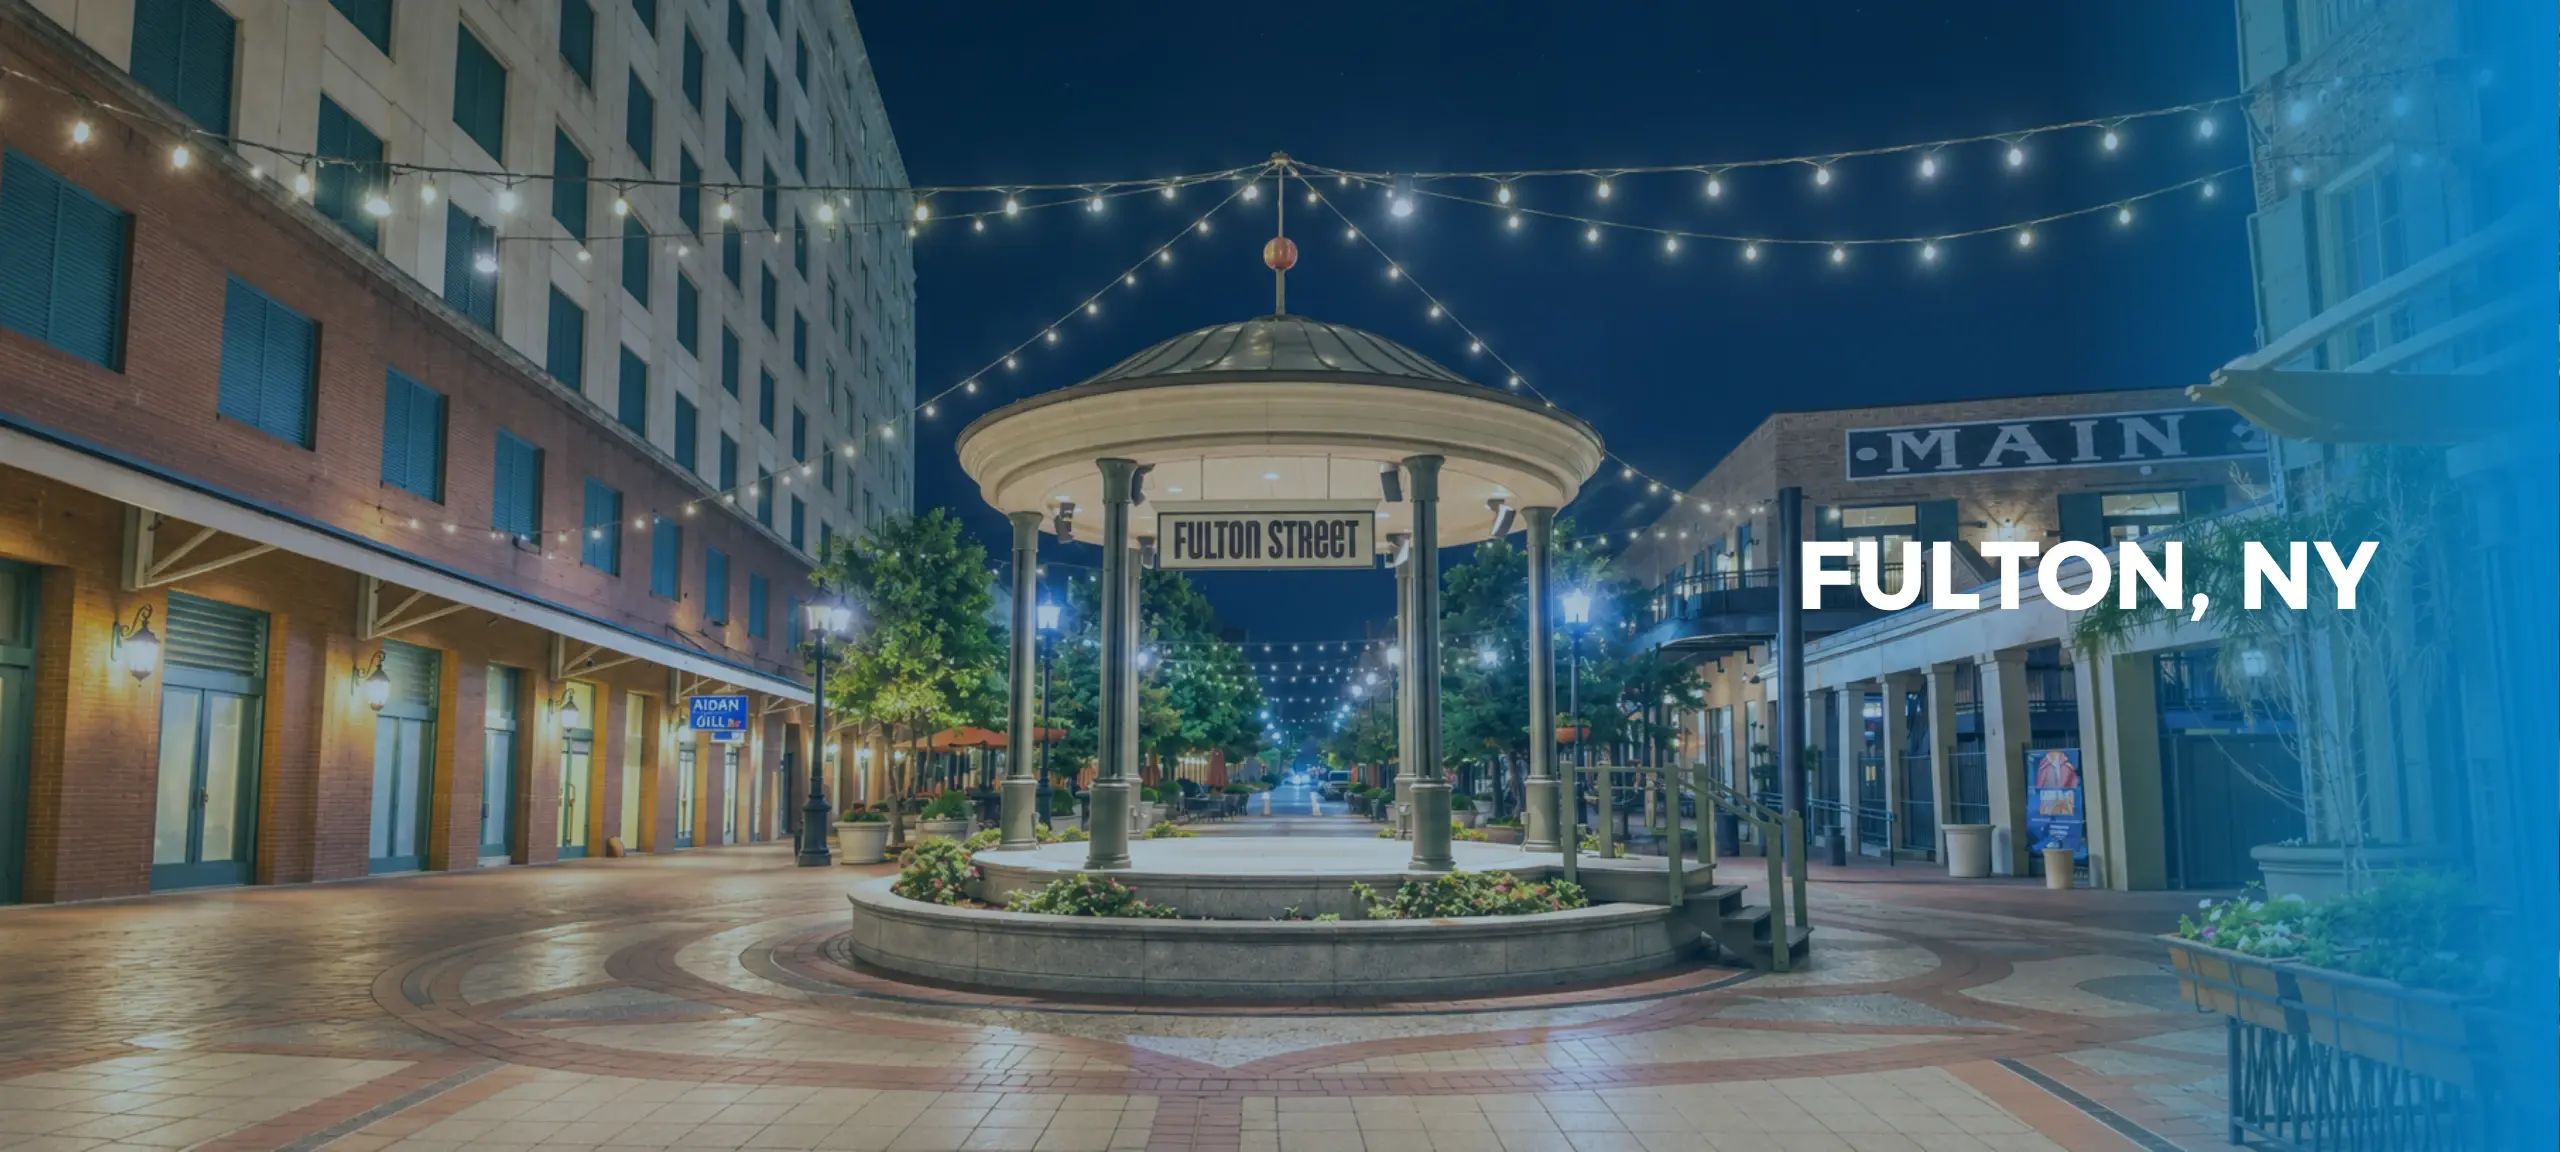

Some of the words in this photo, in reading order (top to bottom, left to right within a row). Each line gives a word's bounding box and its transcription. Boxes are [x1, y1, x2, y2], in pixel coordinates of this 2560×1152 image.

[1886, 414, 2188, 473] MAIN
[1173, 520, 1261, 560] FULTON
[1267, 519, 1360, 560] STREET
[692, 698, 740, 713] AIDAN
